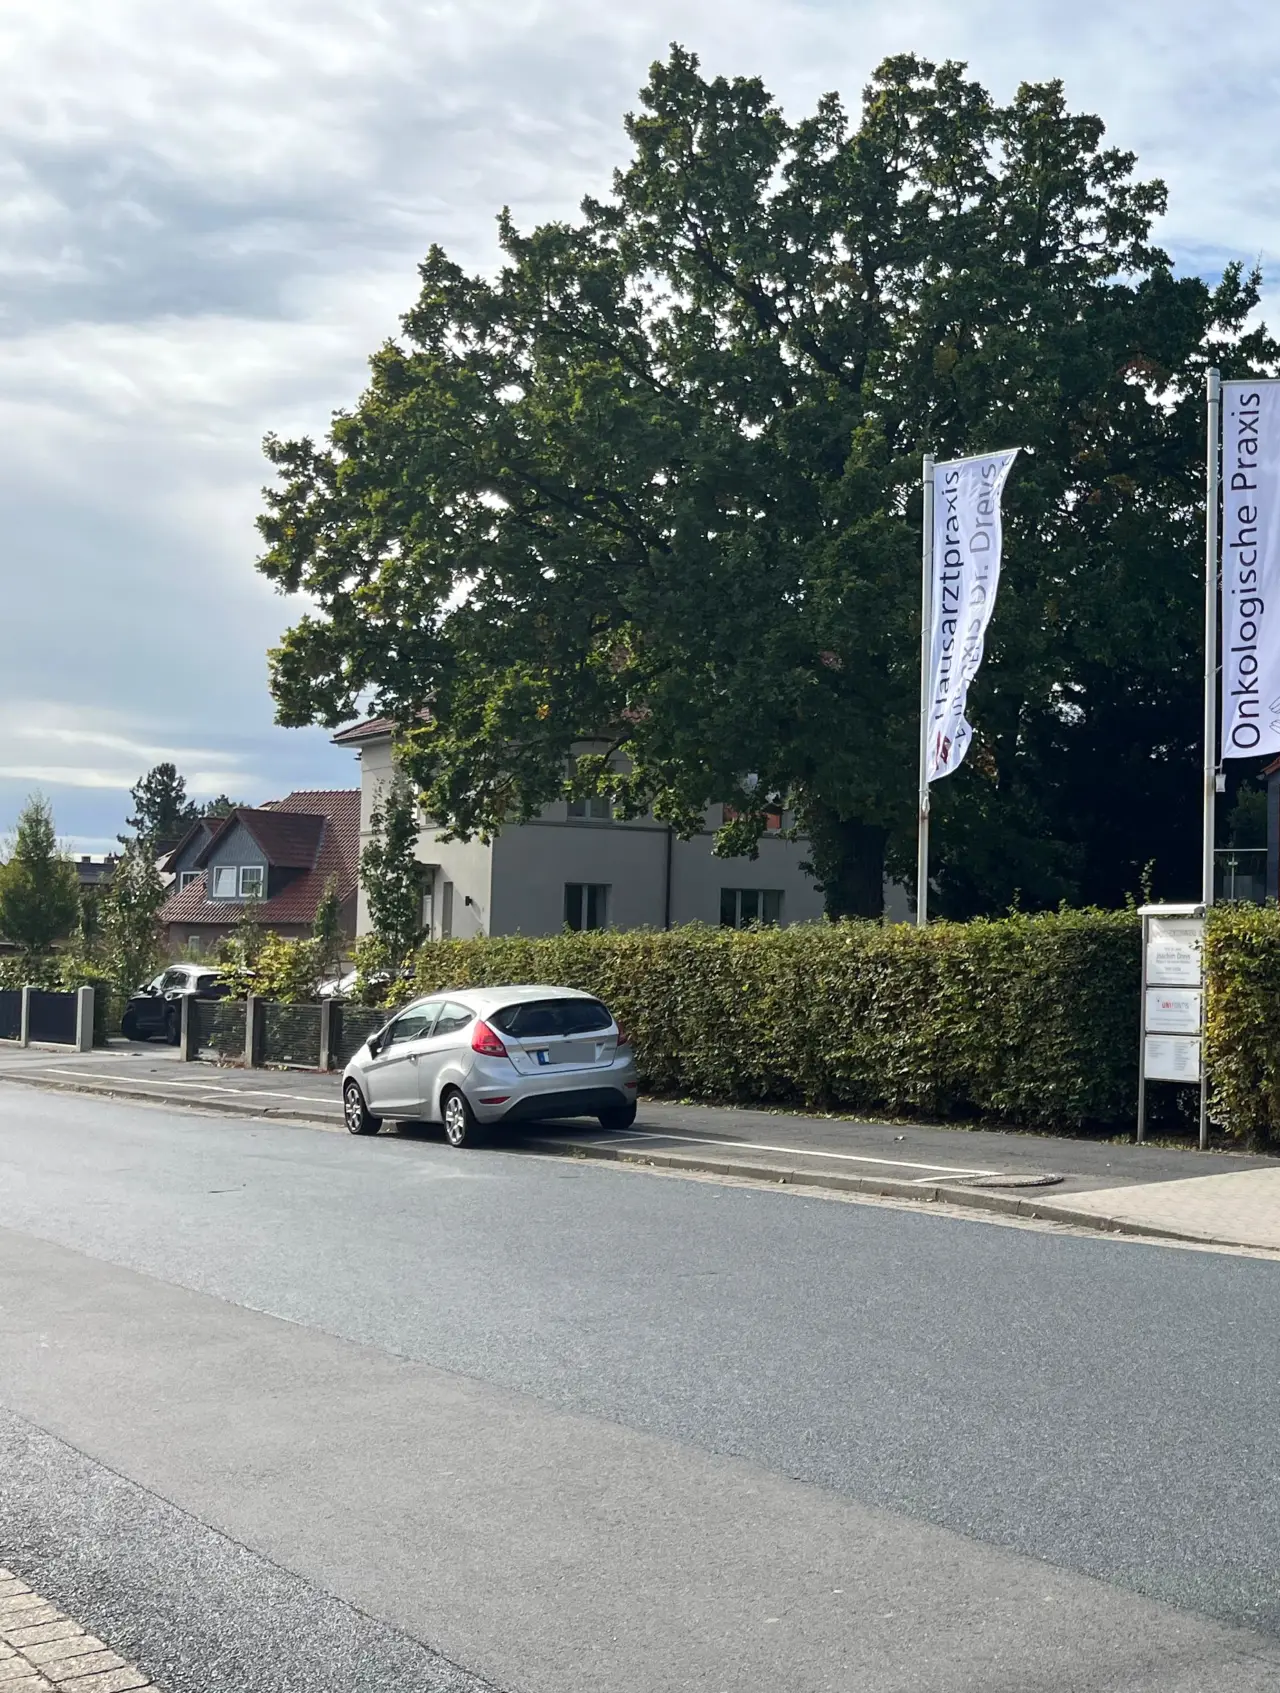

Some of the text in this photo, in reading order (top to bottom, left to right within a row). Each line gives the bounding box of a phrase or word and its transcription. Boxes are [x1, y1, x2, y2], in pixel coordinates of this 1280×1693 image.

[969, 564, 989, 607] Dr.
[1229, 391, 1265, 750] Onkologische Praxis
